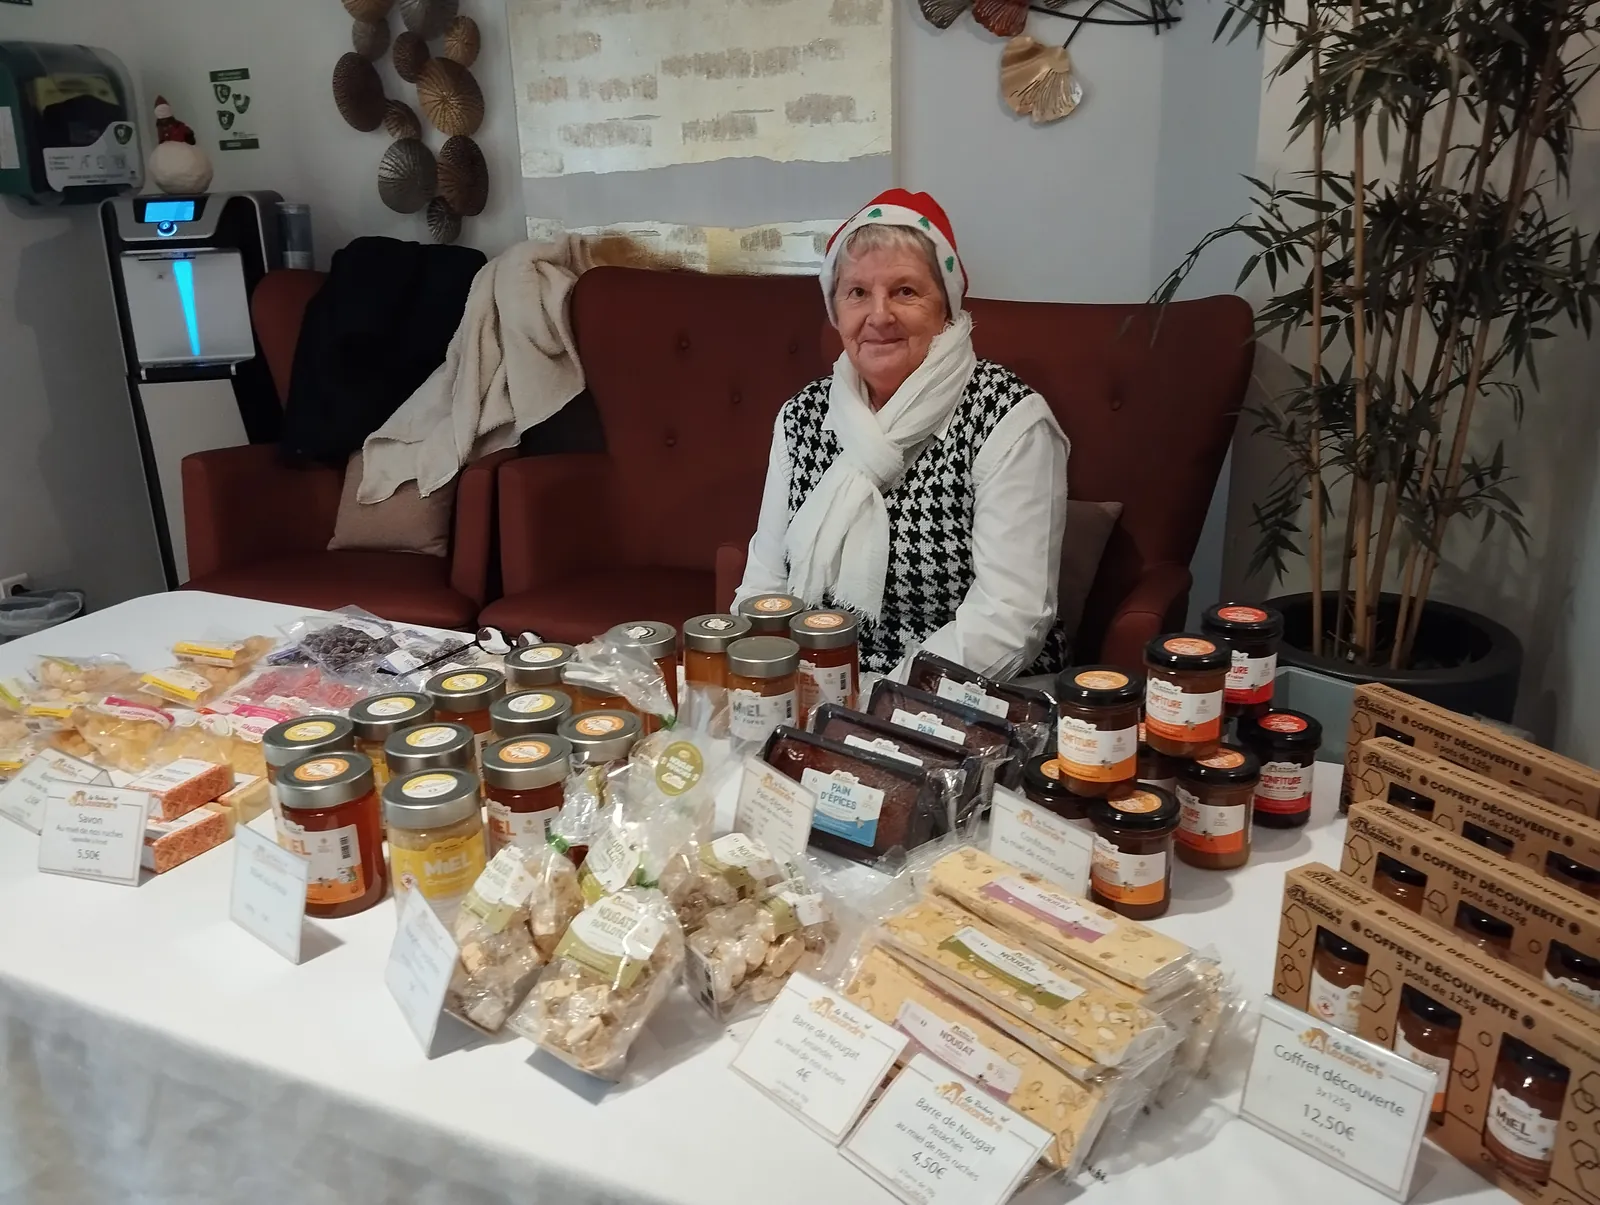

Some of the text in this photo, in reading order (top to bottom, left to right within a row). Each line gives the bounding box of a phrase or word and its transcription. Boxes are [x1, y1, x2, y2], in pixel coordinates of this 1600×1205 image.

[1410, 719, 1452, 742] COFFRET
[1454, 737, 1521, 772] DÉCOUVERTE
[78, 812, 103, 825] Savon
[1430, 780, 1562, 842] COFFRET DÉCOUVERTE
[1457, 804, 1464, 814] 3
[1465, 809, 1487, 824] pots
[1487, 817, 1502, 831] de
[77, 848, 101, 861] 5,50€
[1422, 851, 1567, 928] COFFRET DÉCOUVERTE
[1452, 880, 1528, 927] 3 pots de 125g
[1363, 927, 1520, 1021] COFFRET DÉCOUVERTE
[1387, 915, 1447, 948] COFFRET
[1446, 947, 1540, 999] DÉCOUVERTE
[1395, 960, 1479, 1017] 3 pots de 125g
[791, 1013, 862, 1062] Barre de Nougat
[939, 1029, 976, 1057] NOUGAT
[795, 1067, 812, 1083] 4€
[1273, 1043, 1406, 1118] Coffret découverte
[915, 1096, 997, 1157] Barre de Nougat
[926, 1122, 965, 1154] Pistaches
[1302, 1102, 1357, 1143] 12,50€
[894, 1120, 981, 1183] au miel de nos ruches
[911, 1149, 949, 1181] 4,50€
